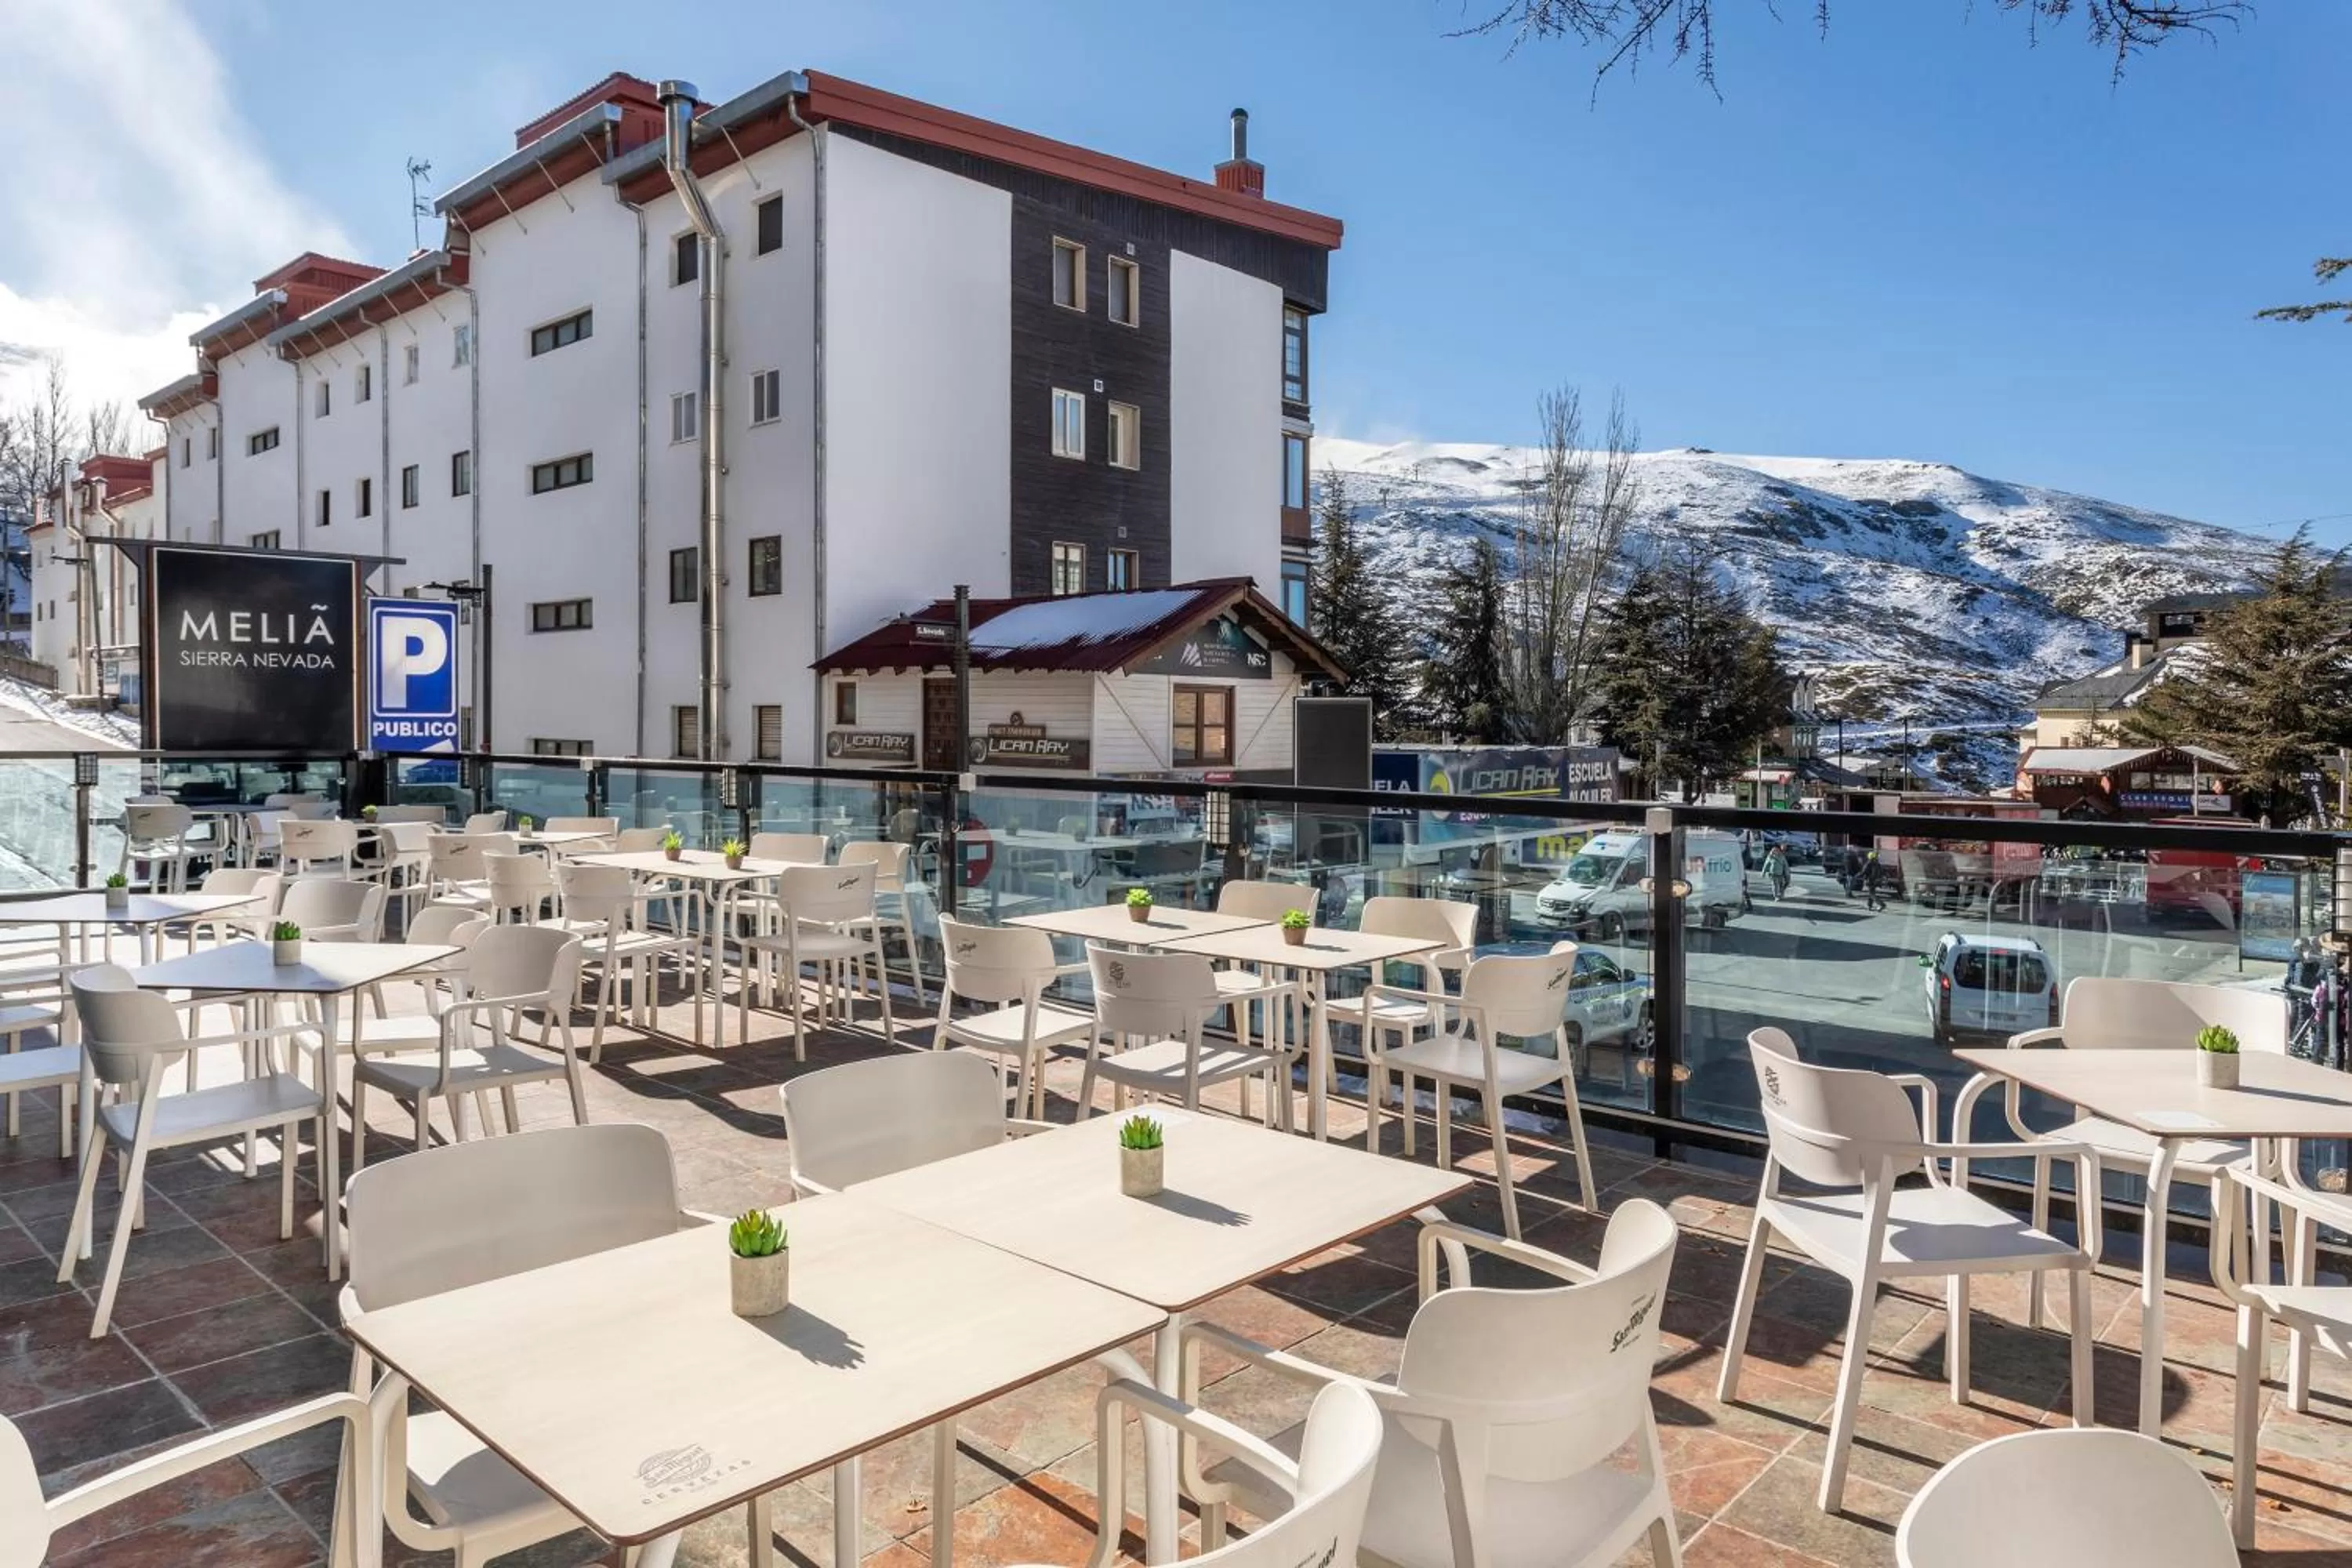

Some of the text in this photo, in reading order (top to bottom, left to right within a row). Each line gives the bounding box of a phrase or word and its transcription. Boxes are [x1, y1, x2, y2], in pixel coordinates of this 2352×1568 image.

[180, 650, 336, 669] SIERRA NEVADA
[381, 615, 448, 709] P
[372, 720, 457, 737] PUBLICO
[1569, 762, 1613, 783] ESCUELA
